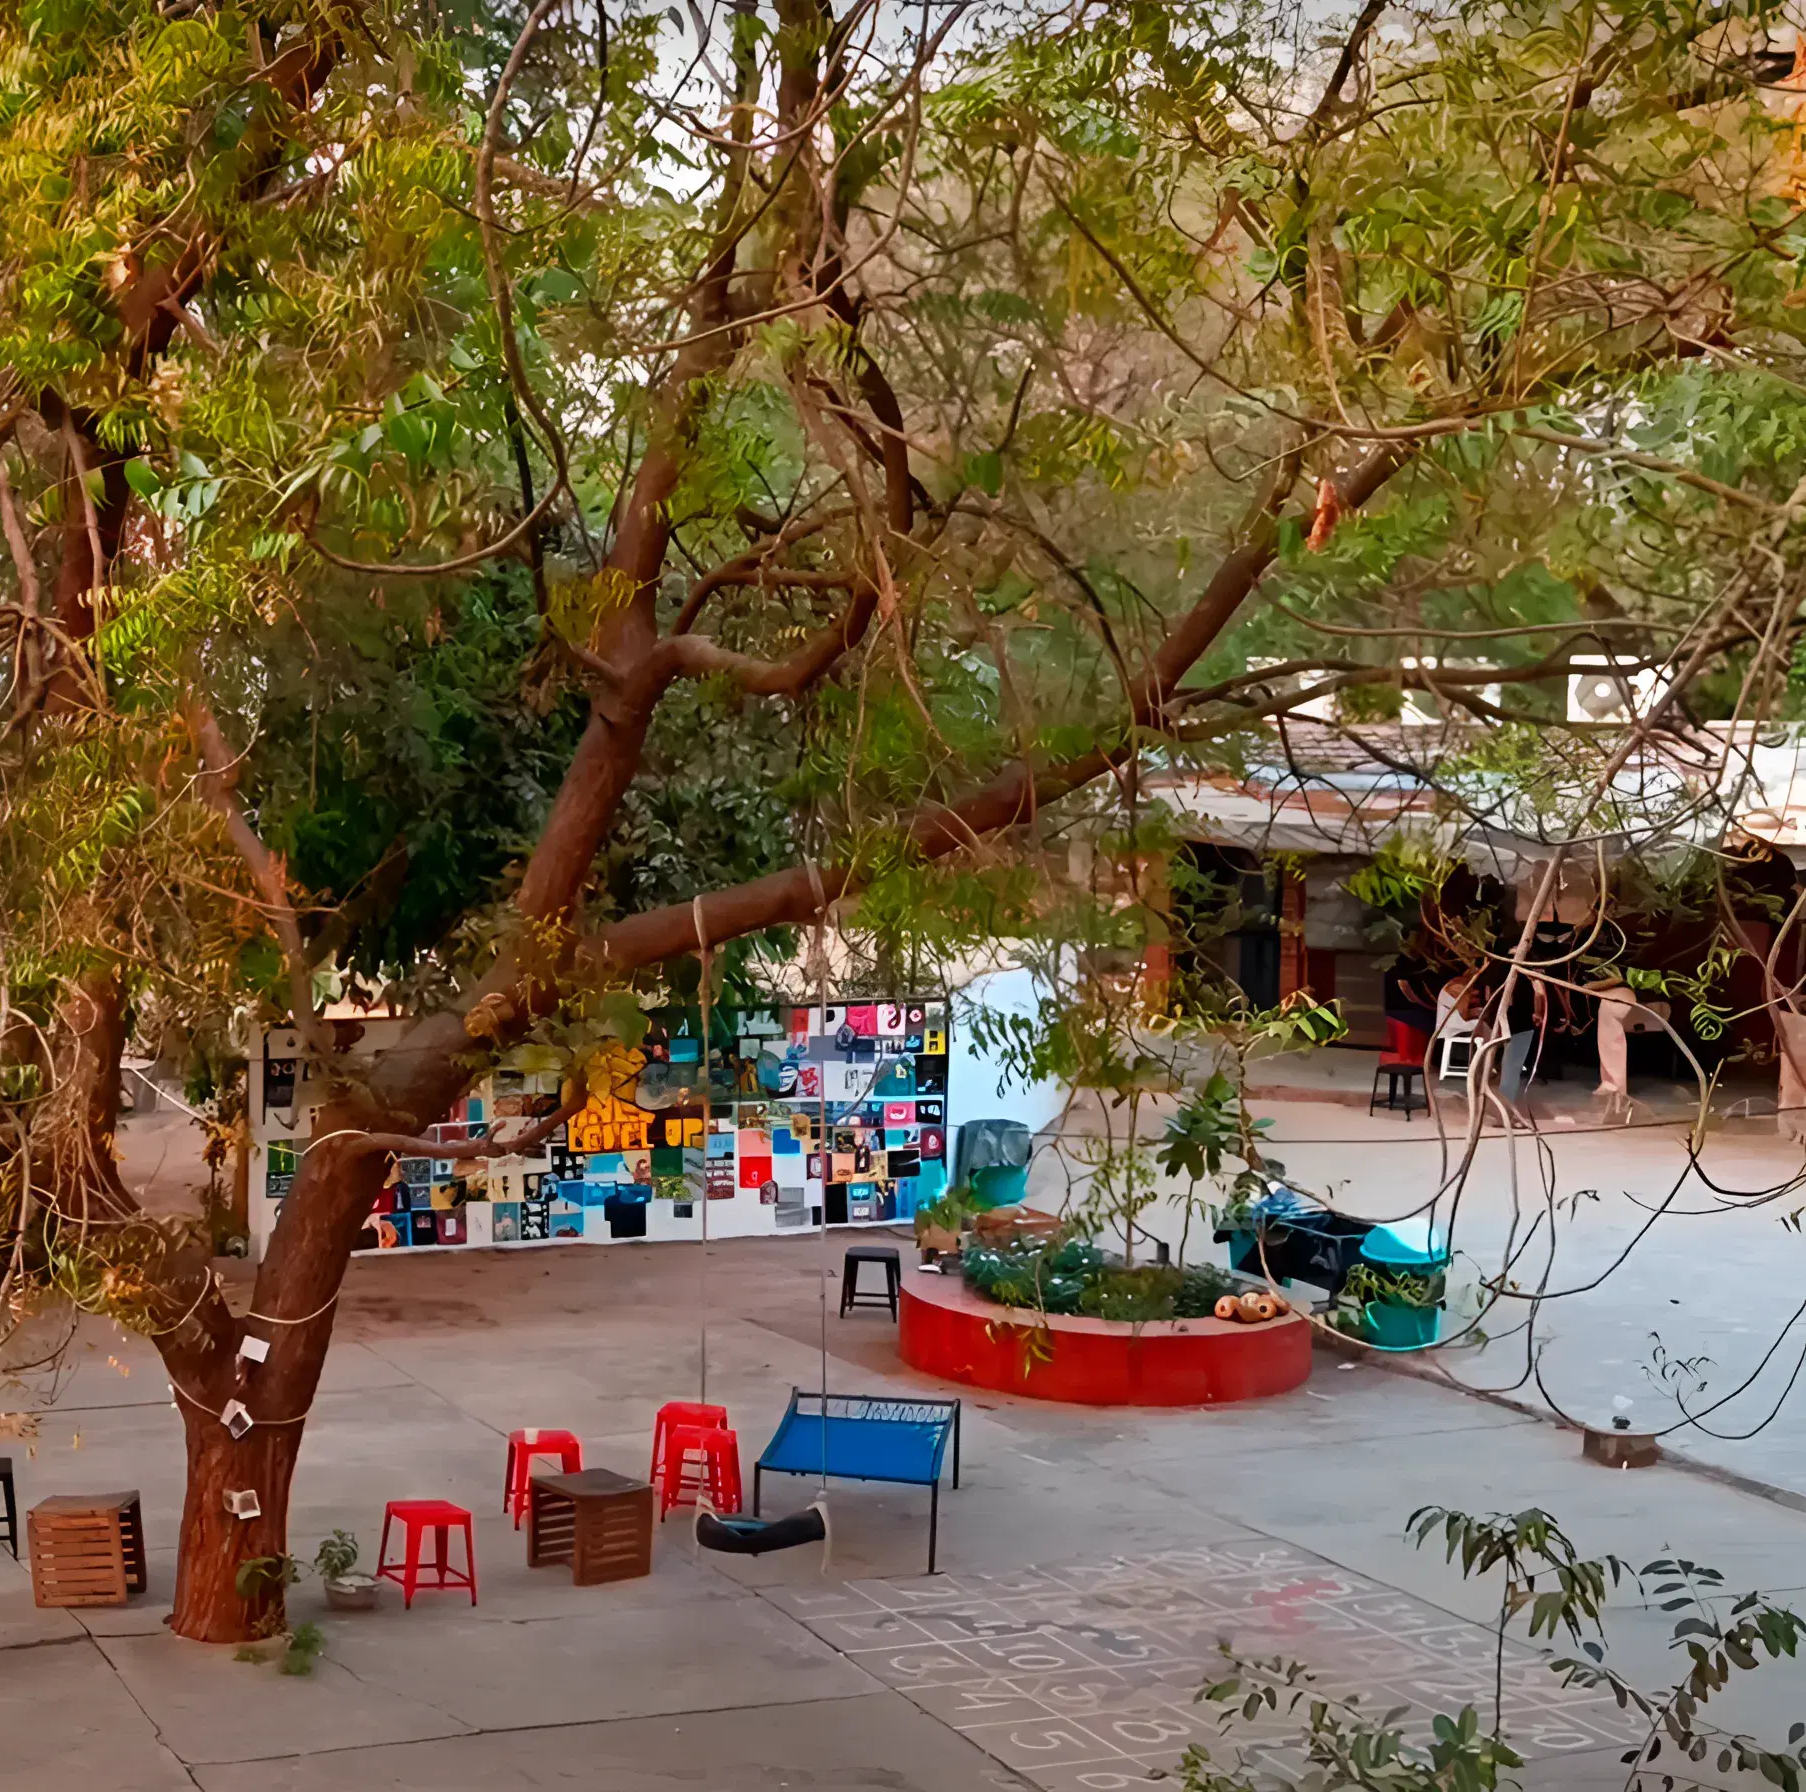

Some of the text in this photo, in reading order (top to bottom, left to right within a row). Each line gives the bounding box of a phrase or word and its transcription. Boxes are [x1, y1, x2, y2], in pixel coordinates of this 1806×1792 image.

[664, 1117, 704, 1147] UP
[979, 1641, 1067, 1670] 10
[1009, 1730, 1089, 1750] 5
[1111, 1719, 1192, 1744] 8
